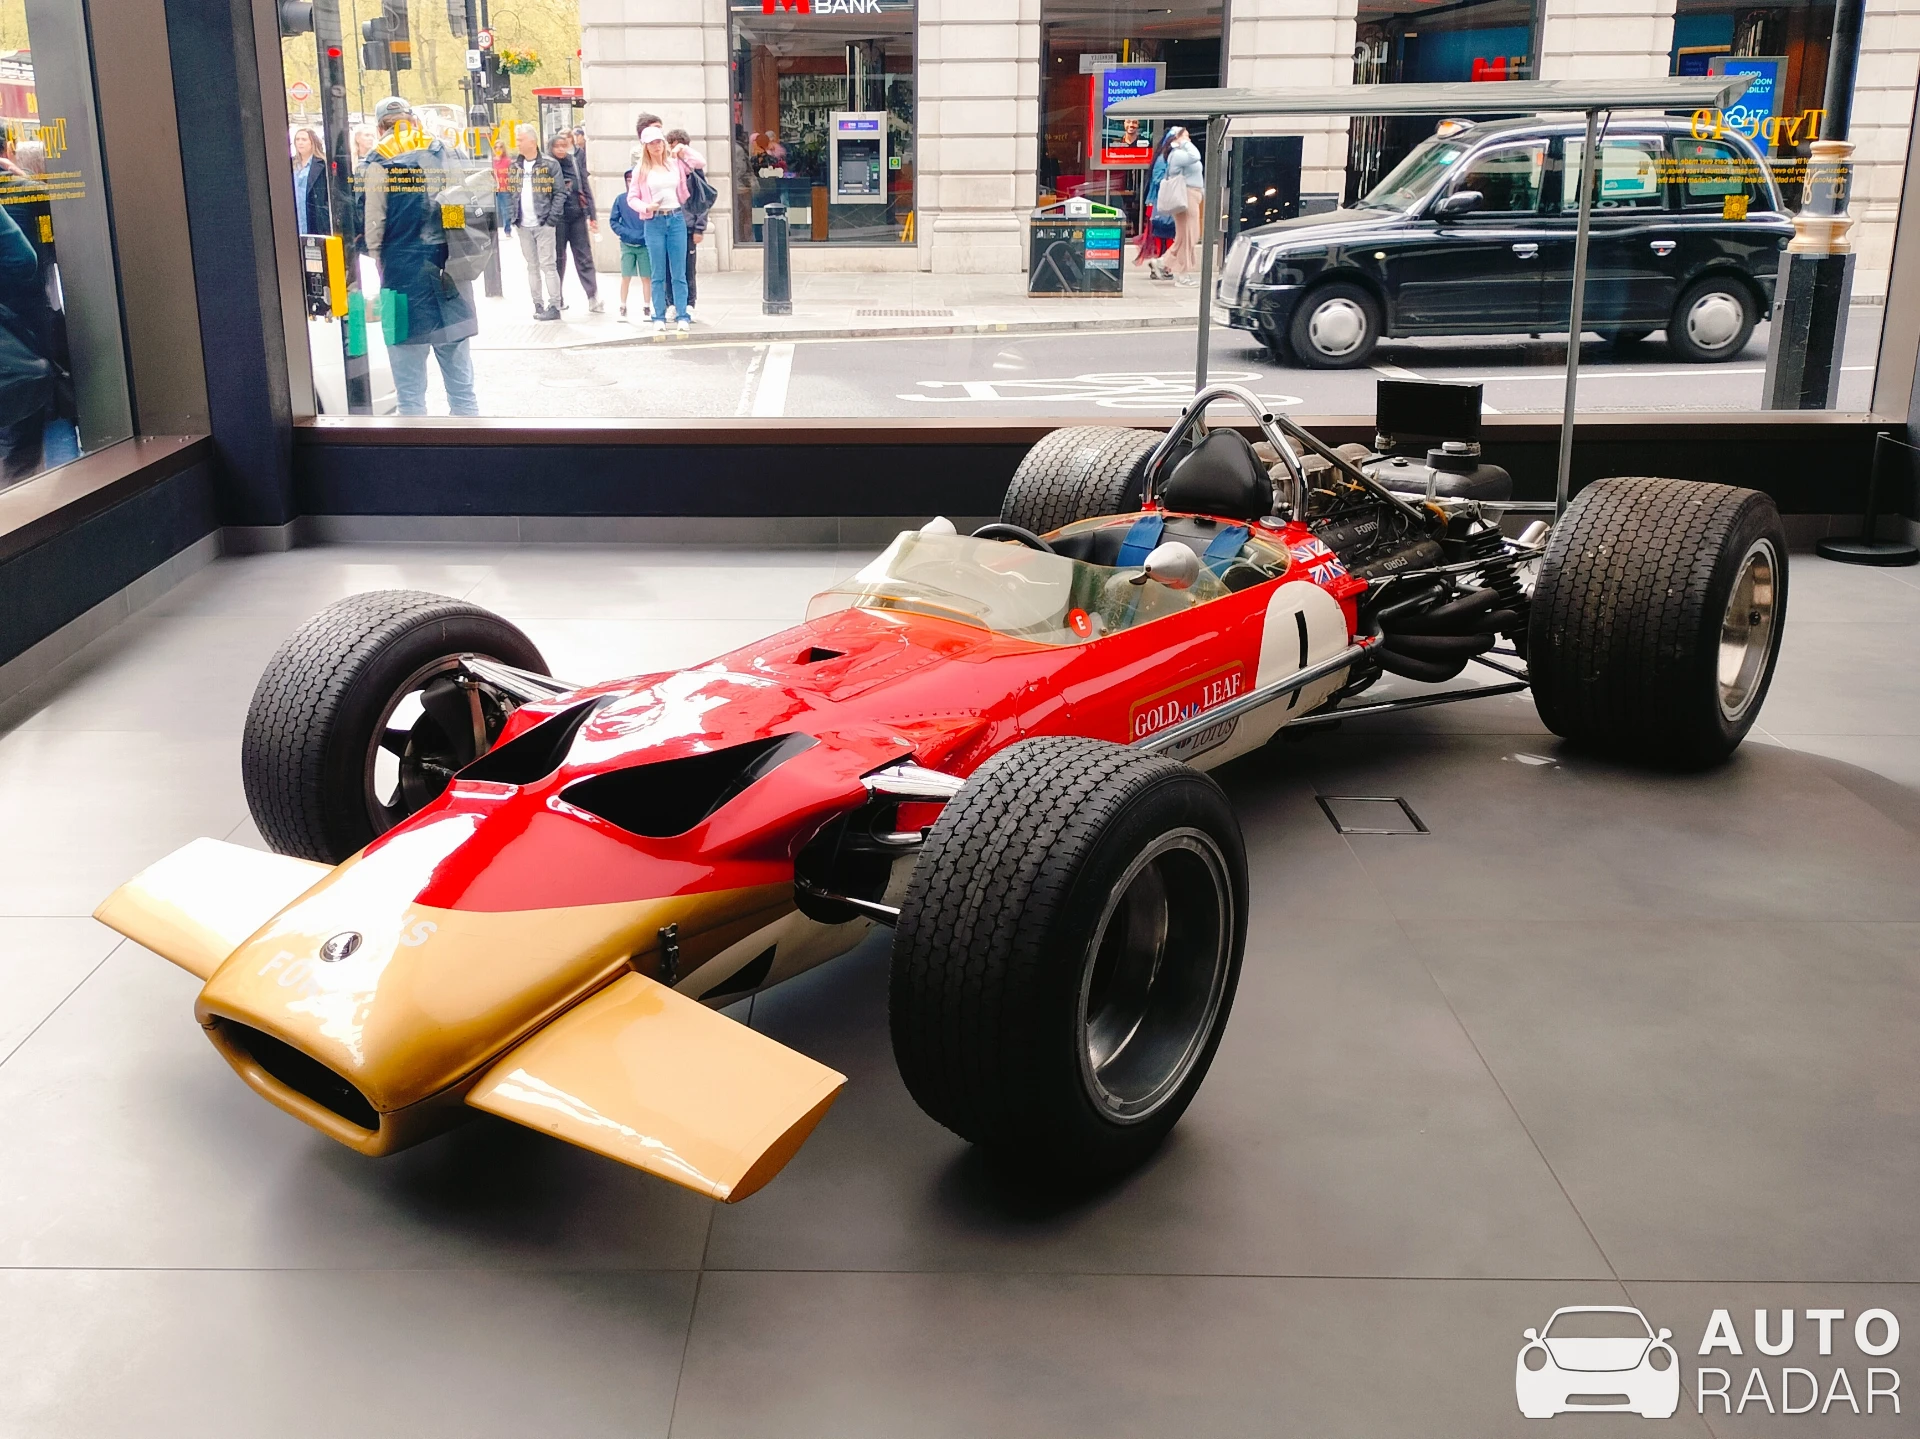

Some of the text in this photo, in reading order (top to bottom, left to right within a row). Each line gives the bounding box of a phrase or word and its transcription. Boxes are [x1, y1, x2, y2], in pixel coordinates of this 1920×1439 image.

[815, 0, 882, 14] BANK
[480, 35, 490, 43] 20
[1120, 79, 1148, 88] monthly
[1354, 521, 1378, 536] FORD
[1383, 556, 1408, 571] FORD
[1076, 615, 1087, 630] E
[1286, 610, 1308, 711] 1
[1135, 672, 1241, 737] GOLD LEAF
[1192, 717, 1234, 750] LOTUS
